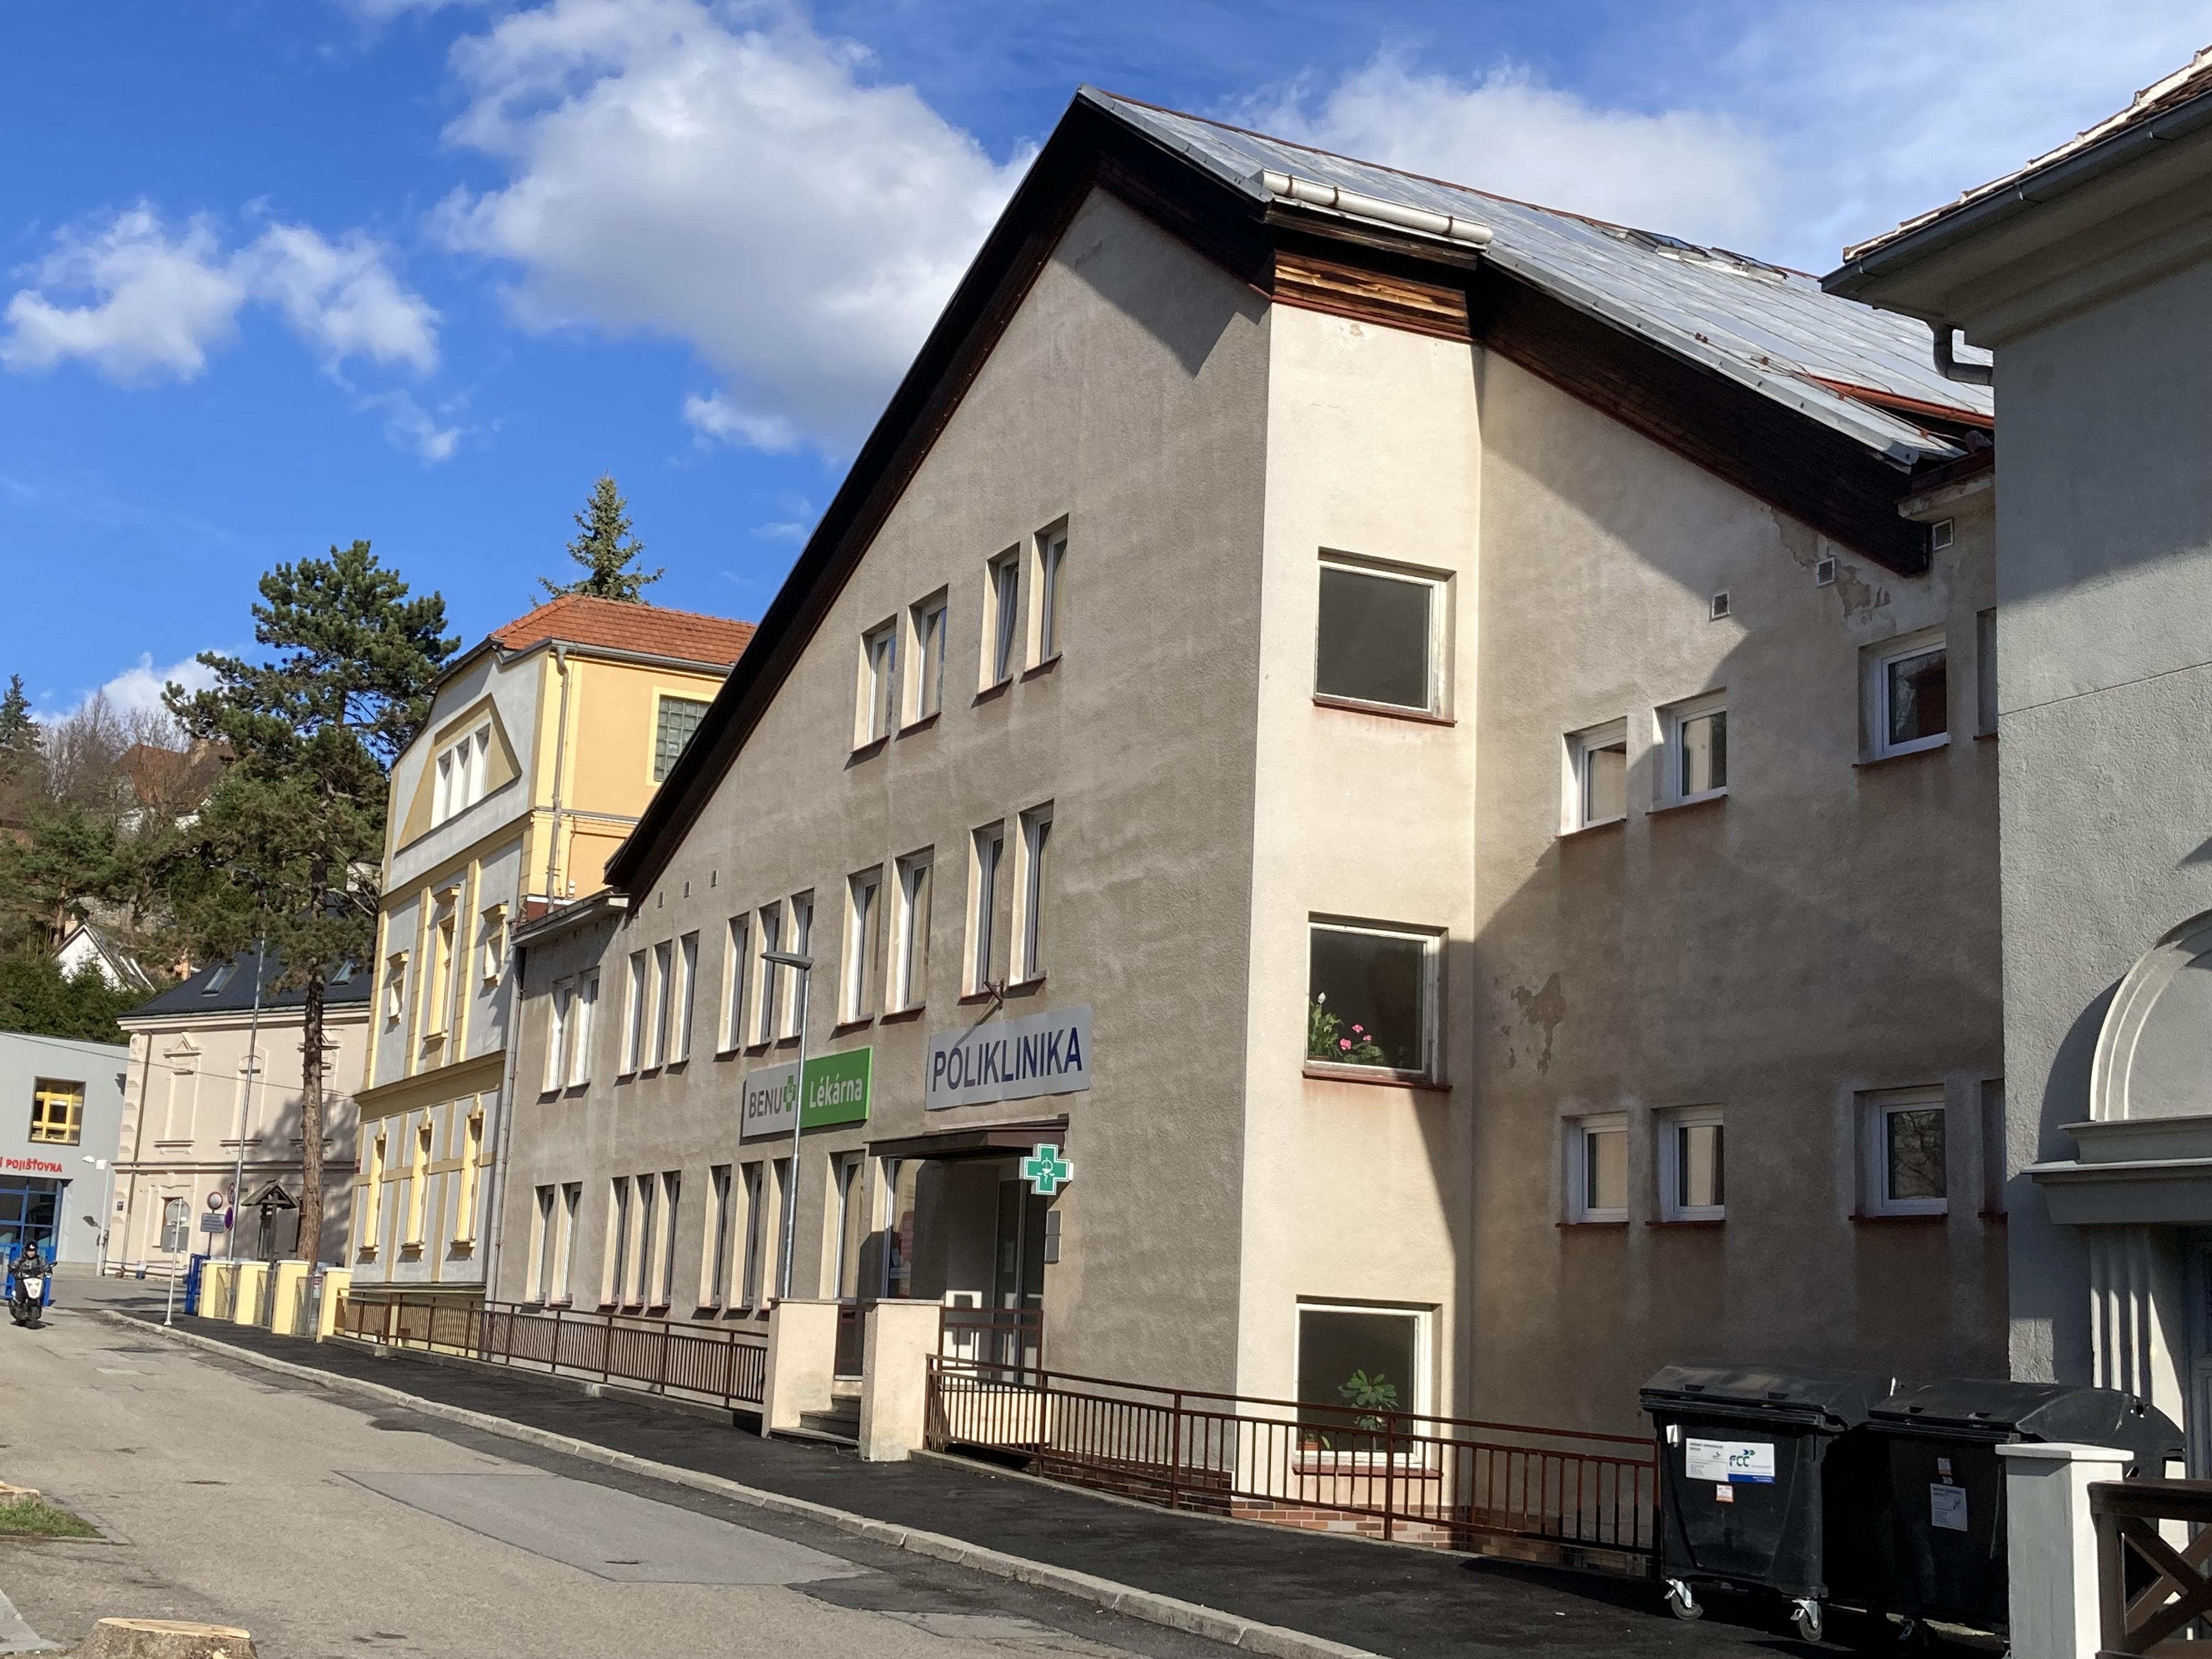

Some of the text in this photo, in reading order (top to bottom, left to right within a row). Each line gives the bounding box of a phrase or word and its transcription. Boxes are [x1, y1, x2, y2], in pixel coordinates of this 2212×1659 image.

[932, 1027, 1082, 1092] POLIKLINIKA
[749, 1073, 863, 1119] BENU Lékárna
[6, 1157, 62, 1172] POJIŠŤOVNA
[1729, 1455, 1750, 1467] FCC
